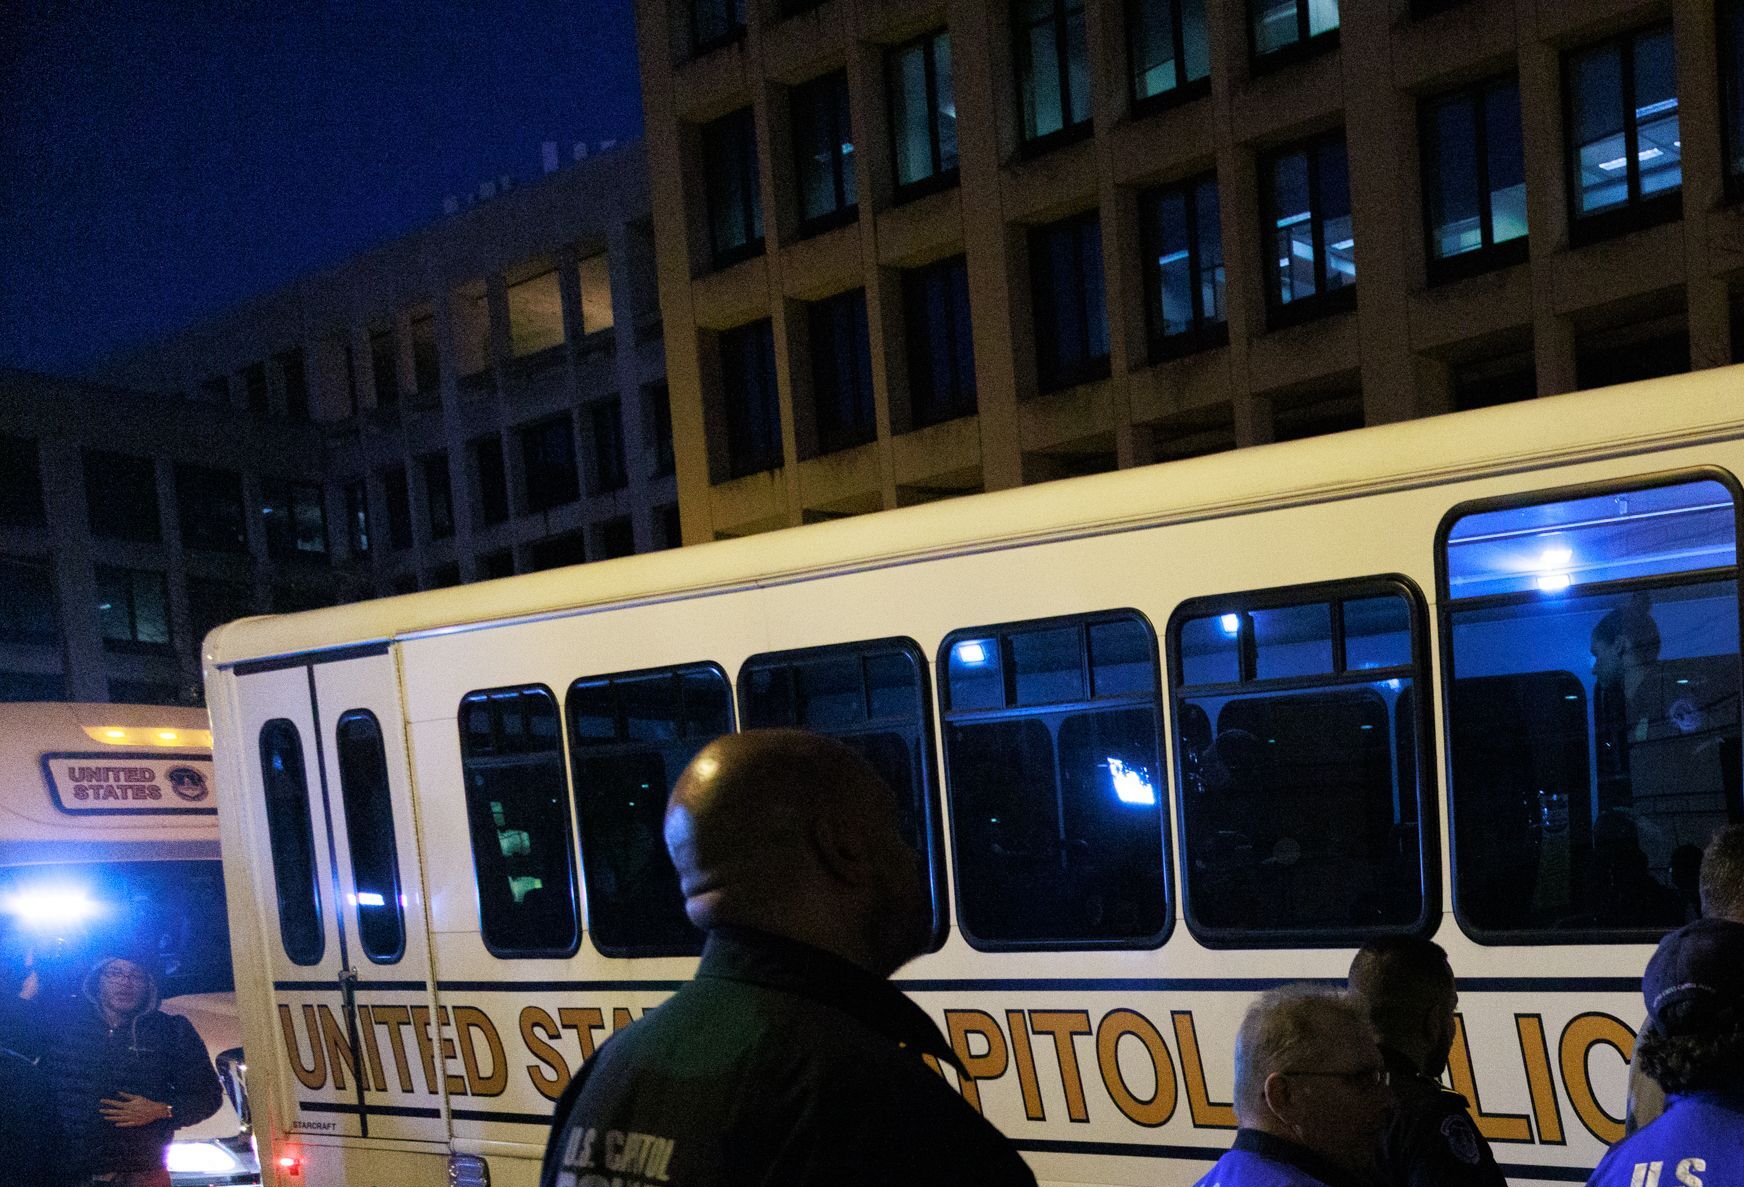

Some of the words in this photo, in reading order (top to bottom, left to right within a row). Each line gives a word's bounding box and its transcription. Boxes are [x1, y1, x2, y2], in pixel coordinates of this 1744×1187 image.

[68, 767, 156, 783] UNITED
[73, 784, 162, 801] STATES
[278, 1004, 508, 1098] UNITED
[921, 1007, 1238, 1128] PITOL
[1447, 1011, 1637, 1146] LIC
[292, 1120, 336, 1131] STARCRAFT
